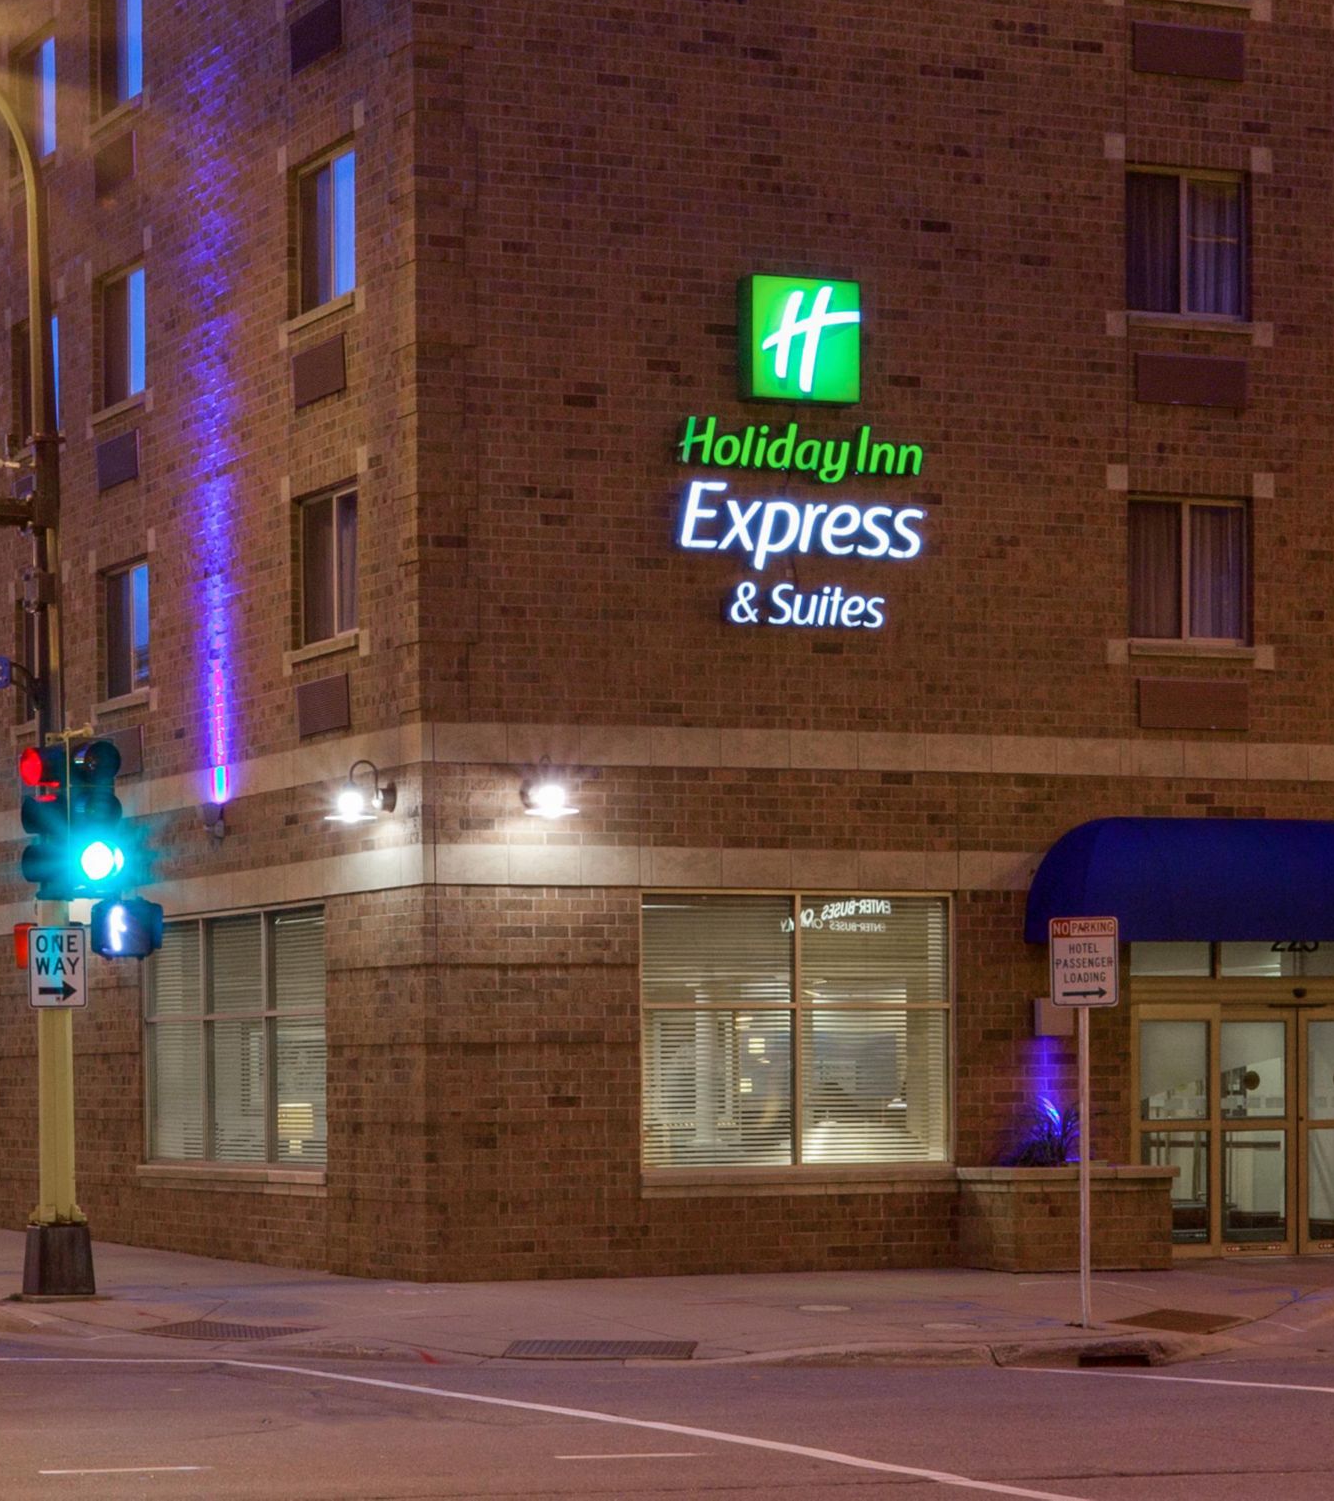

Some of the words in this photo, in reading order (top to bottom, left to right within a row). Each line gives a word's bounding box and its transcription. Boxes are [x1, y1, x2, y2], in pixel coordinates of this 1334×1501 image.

[678, 416, 849, 484] Holiday
[855, 426, 924, 476] Inn
[679, 480, 927, 571] Express
[729, 581, 759, 624] &
[768, 583, 885, 629] Suites
[1053, 921, 1069, 935] NO
[1072, 920, 1114, 933] PARKING
[36, 934, 78, 953] ONE
[1068, 942, 1099, 954] HOTEL
[35, 957, 80, 975] WAY
[1055, 957, 1113, 969] PASSENGER
[1063, 972, 1106, 984] LOADING
